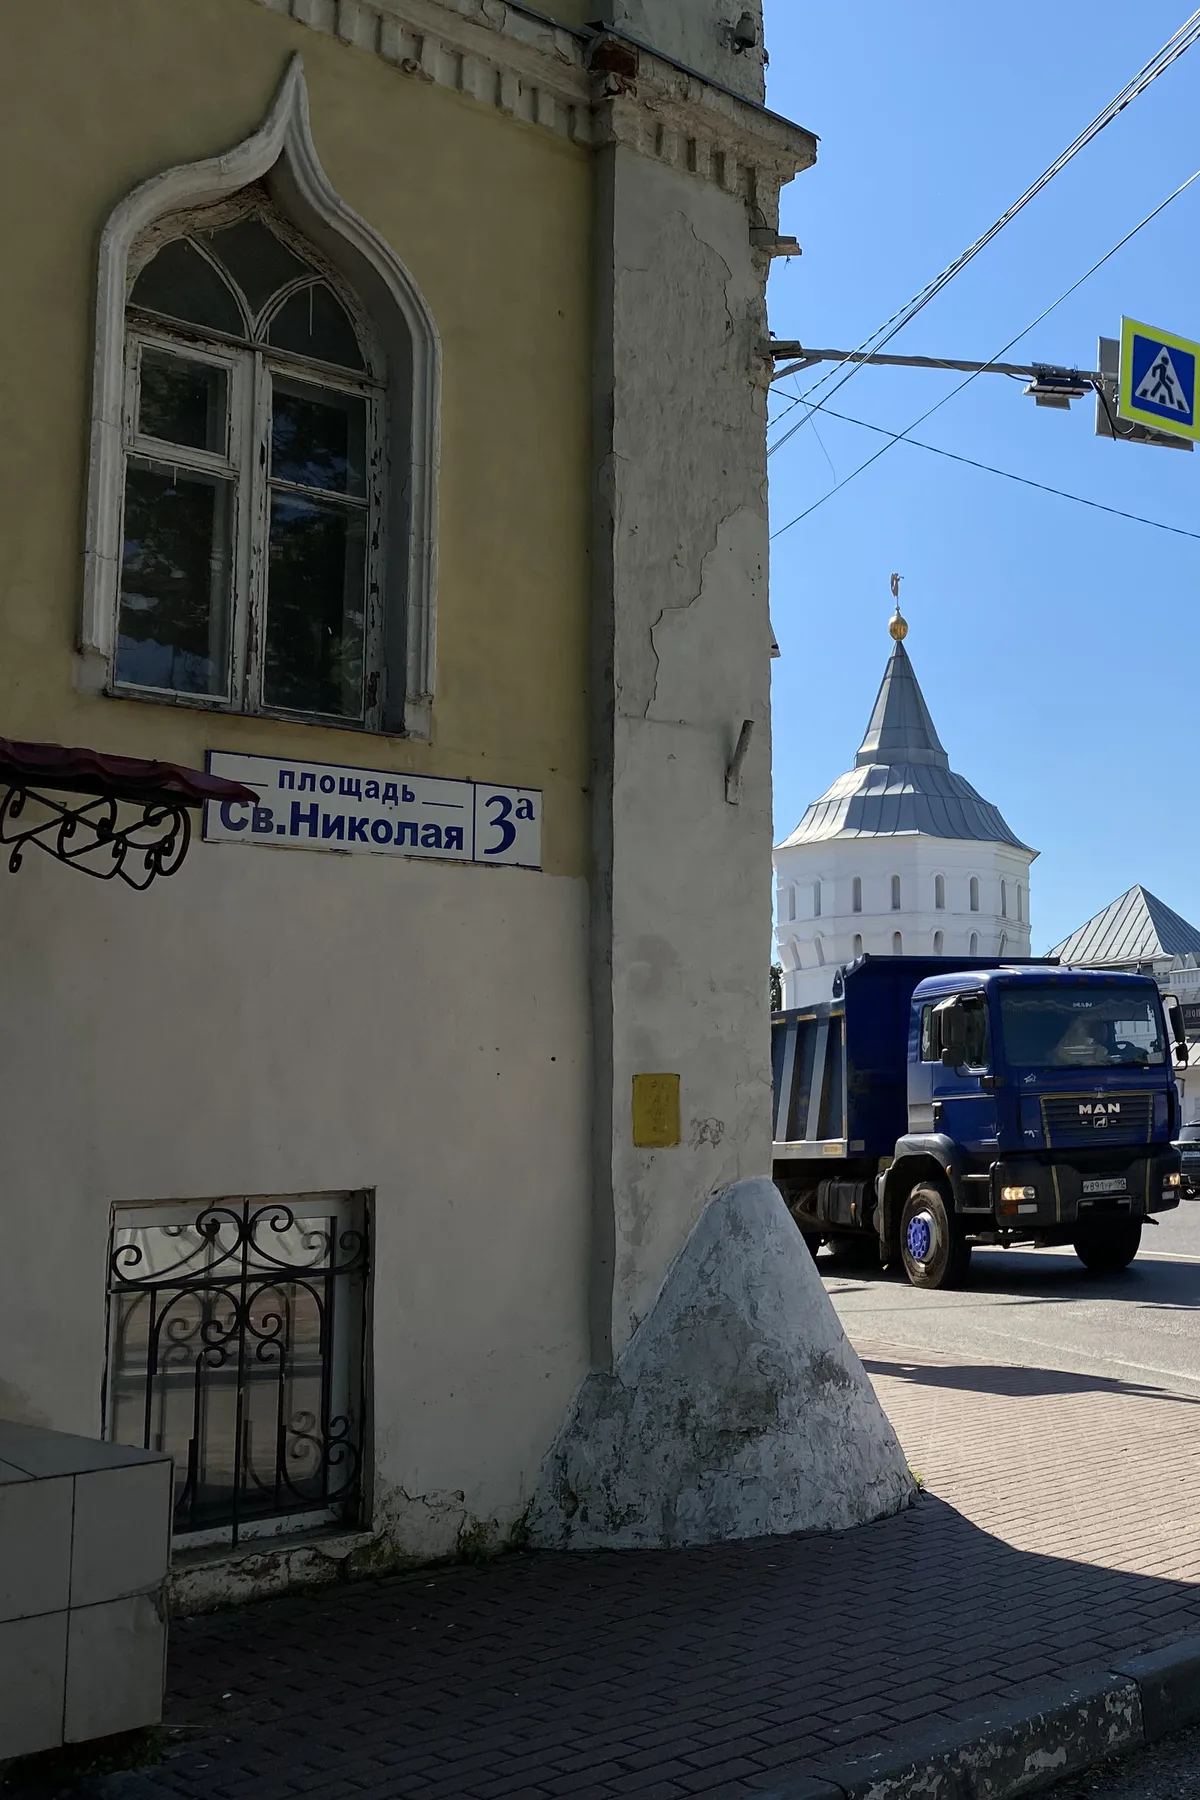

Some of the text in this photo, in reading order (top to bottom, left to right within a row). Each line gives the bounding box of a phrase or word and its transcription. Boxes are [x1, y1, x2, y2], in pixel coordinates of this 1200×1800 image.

[278, 769, 416, 806] площадь
[219, 798, 464, 851] Св.Николая
[1078, 1102, 1120, 1115] MAN
